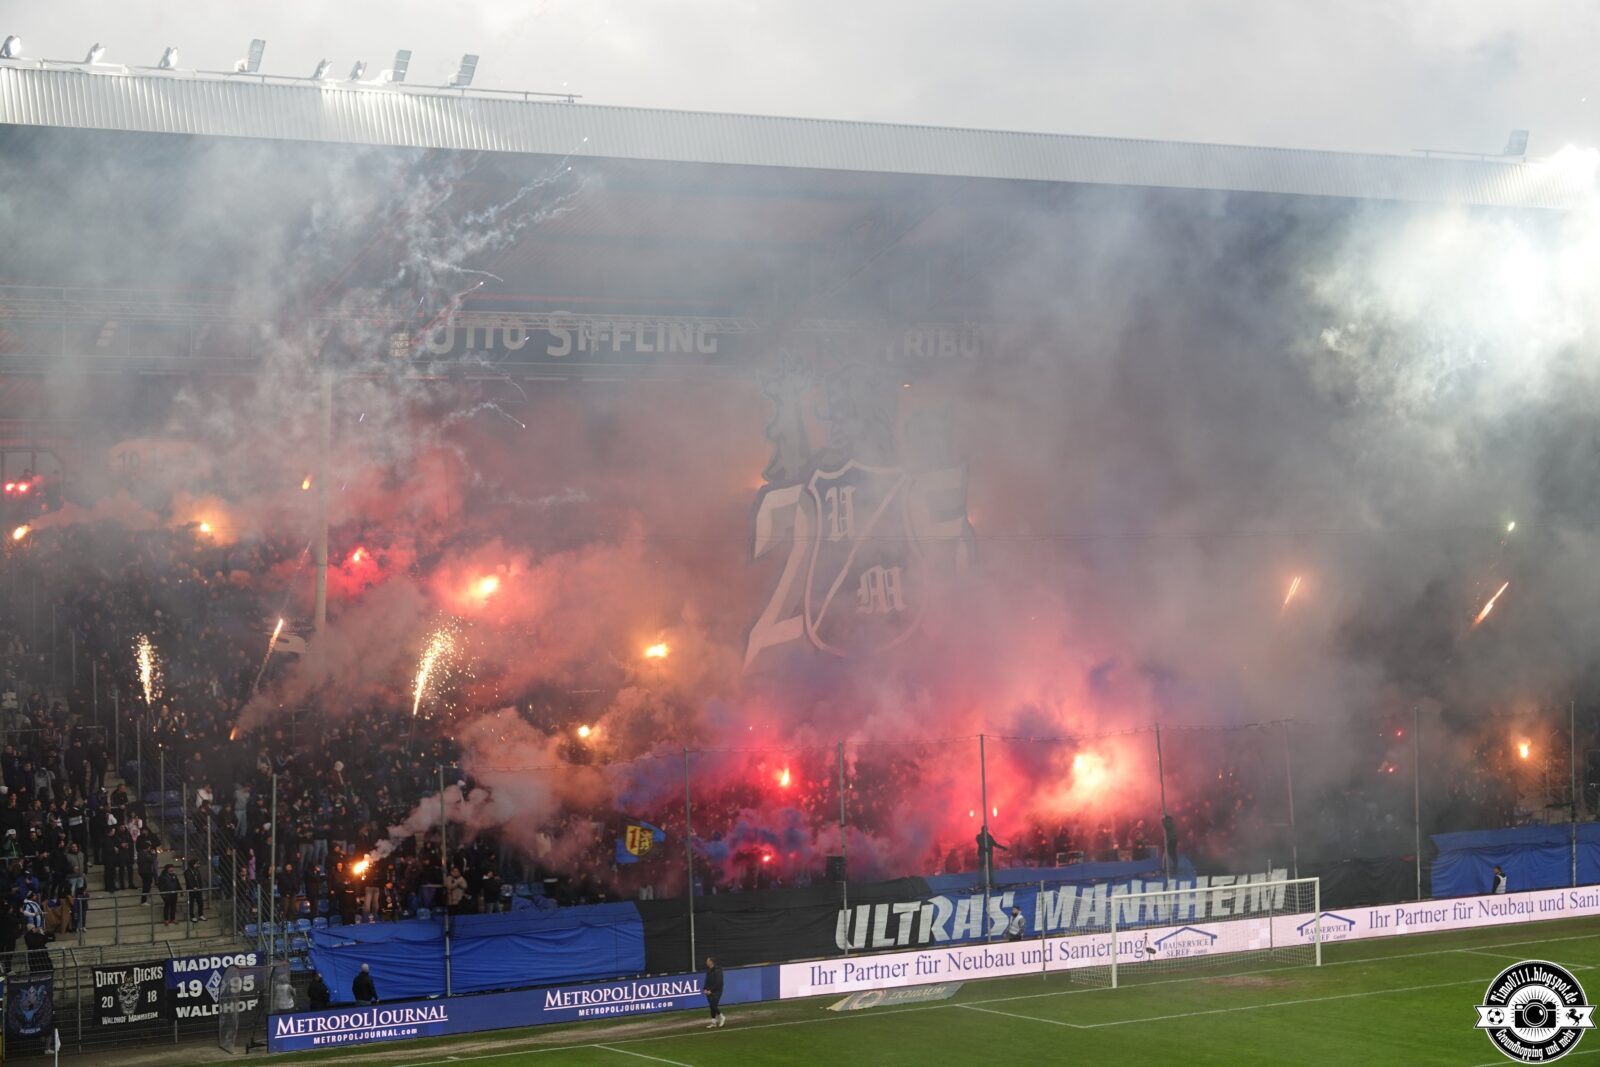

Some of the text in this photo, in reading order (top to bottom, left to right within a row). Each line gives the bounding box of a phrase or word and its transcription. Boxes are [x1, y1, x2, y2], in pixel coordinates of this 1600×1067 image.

[547, 310, 718, 357] SIFFLING
[836, 869, 1287, 950] ULTRAS MANNHEIM
[1369, 910, 1391, 929] Ihr
[1395, 907, 1448, 926] Partner
[1453, 901, 1474, 921] für
[1478, 897, 1534, 918] Neubau
[1539, 892, 1565, 908] und
[172, 953, 257, 973] MADDOGS
[810, 938, 1144, 986] Ihr Partner für Neubau und Sanierung
[95, 966, 163, 988] DIRTY DICKS
[176, 979, 203, 998] 19
[230, 974, 255, 993] 95
[101, 990, 157, 1009] 20 18
[175, 998, 259, 1019] WALDHOF
[578, 1001, 673, 1017] METROPOLJOURNAL.com
[313, 1028, 418, 1045] METROPOLJOURNAL.com
